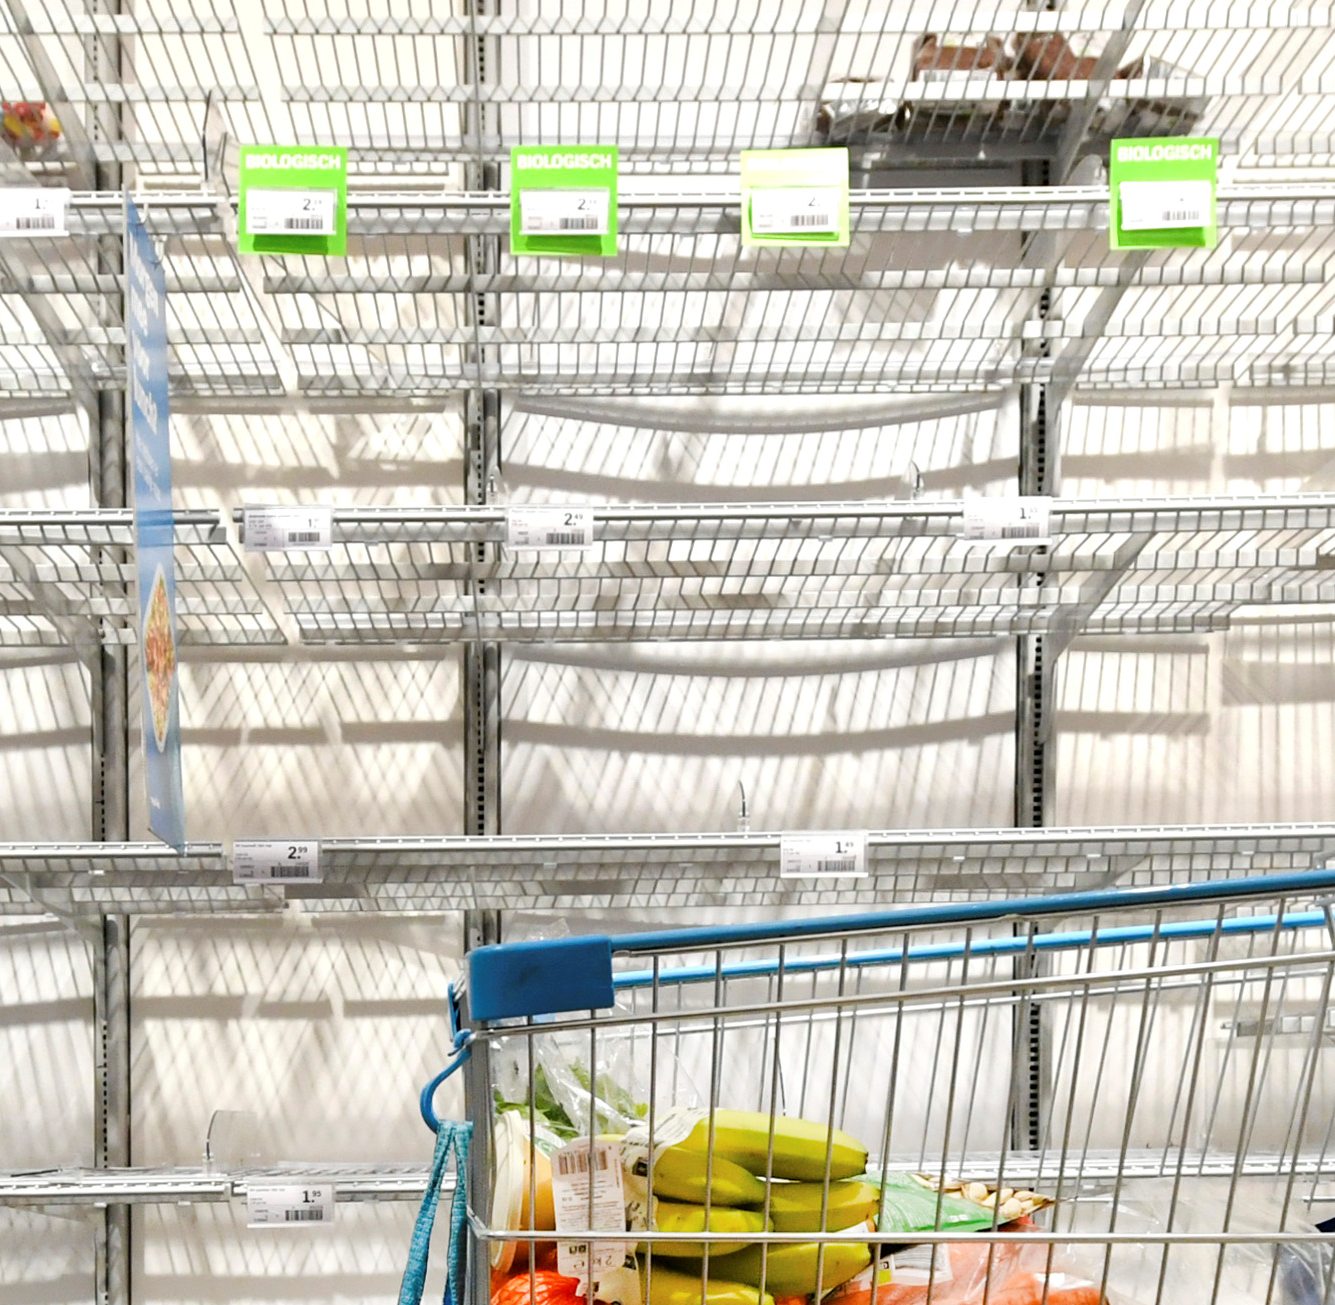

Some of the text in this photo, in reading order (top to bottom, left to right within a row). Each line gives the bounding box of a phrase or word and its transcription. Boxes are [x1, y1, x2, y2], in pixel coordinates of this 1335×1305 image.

[1118, 145, 1212, 162] BIOLOGISCH
[245, 154, 341, 169] BIOLOGISCH
[517, 154, 612, 169] BIOLOGISCH
[563, 512, 583, 526] 2.49
[287, 846, 308, 860] 2.99
[302, 1190, 322, 1203] 1.95
